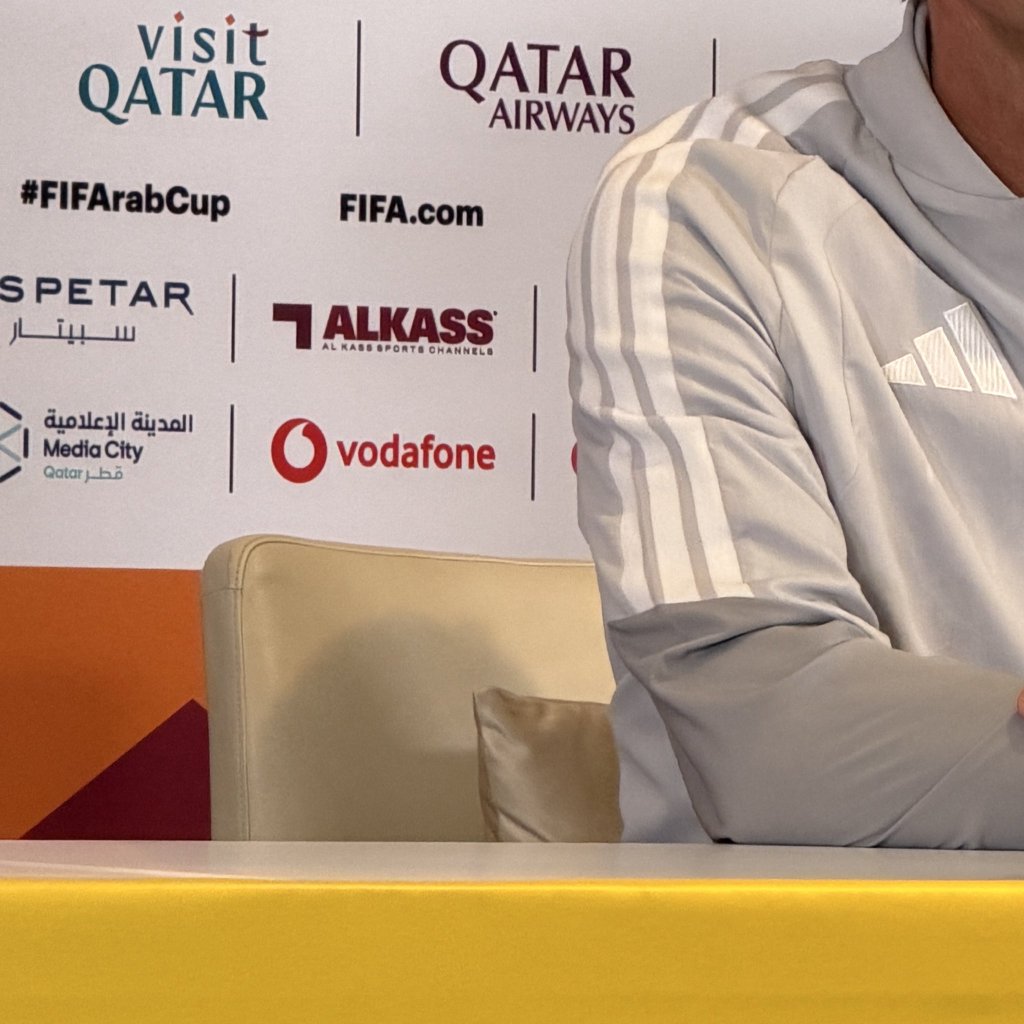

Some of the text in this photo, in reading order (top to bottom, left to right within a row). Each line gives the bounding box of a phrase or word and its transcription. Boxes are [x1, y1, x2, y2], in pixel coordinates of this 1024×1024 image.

[137, 10, 269, 66] visit
[440, 39, 636, 104] QATAR
[78, 63, 269, 125] QATAR
[488, 97, 636, 135] AIRWAYS
[20, 179, 231, 222] #FIFArabCup
[340, 193, 484, 227] FIFA.com
[322, 305, 494, 345] ALKASS
[376, 344, 425, 354] SPORTS
[429, 346, 494, 356] CHANNELS
[43, 439, 144, 464] Media City
[336, 433, 496, 471] vodafone
[43, 465, 83, 480] Qatar
